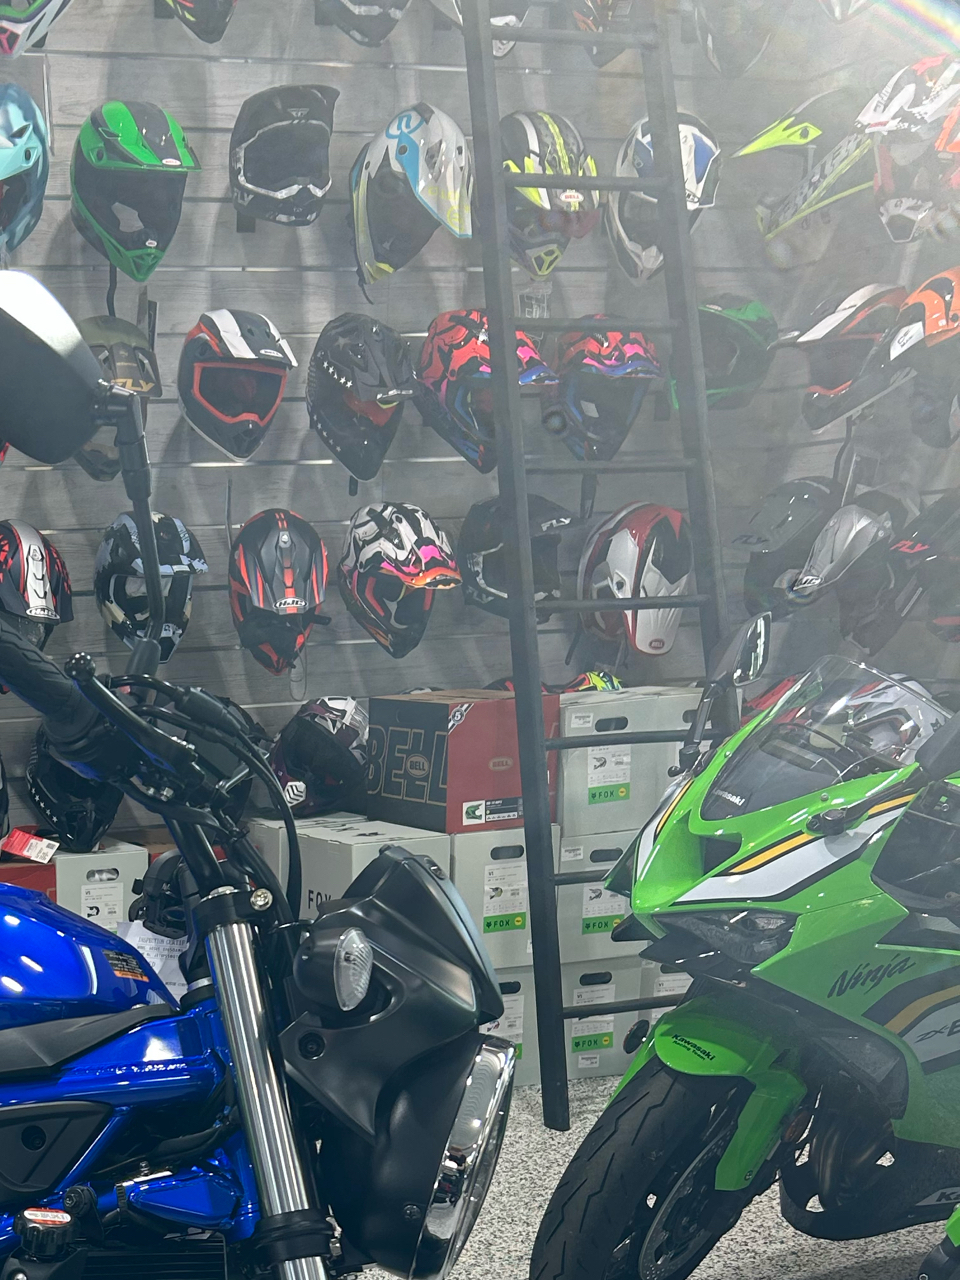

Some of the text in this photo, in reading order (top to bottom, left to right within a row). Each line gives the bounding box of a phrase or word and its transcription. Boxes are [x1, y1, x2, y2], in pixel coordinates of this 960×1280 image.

[409, 760, 427, 772] BELL
[597, 789, 615, 799] FOX
[493, 919, 510, 928] FOX
[592, 920, 609, 930] FOX
[827, 953, 917, 998] Ninja
[581, 1039, 598, 1048] FOX
[671, 1033, 716, 1061] Kawasaki
